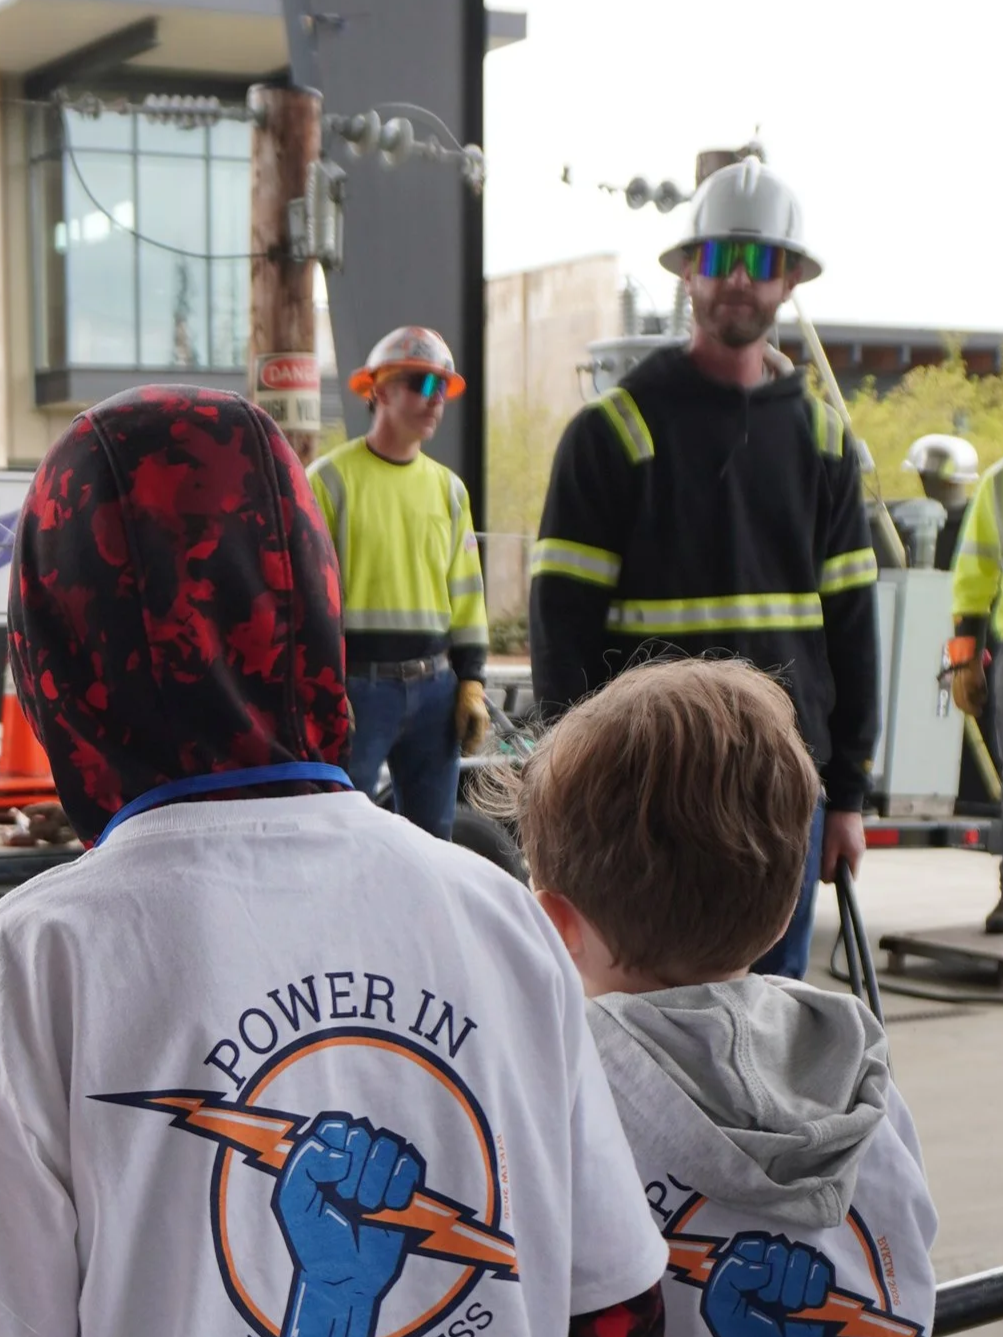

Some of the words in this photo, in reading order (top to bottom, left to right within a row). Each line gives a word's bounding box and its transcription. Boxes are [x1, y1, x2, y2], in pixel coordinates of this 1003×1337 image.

[270, 364, 318, 382] DANG
[204, 971, 395, 1092] POWER
[408, 988, 478, 1060] IN
[877, 1235, 895, 1277] BYKTW
[888, 1279, 901, 1306] 2026
